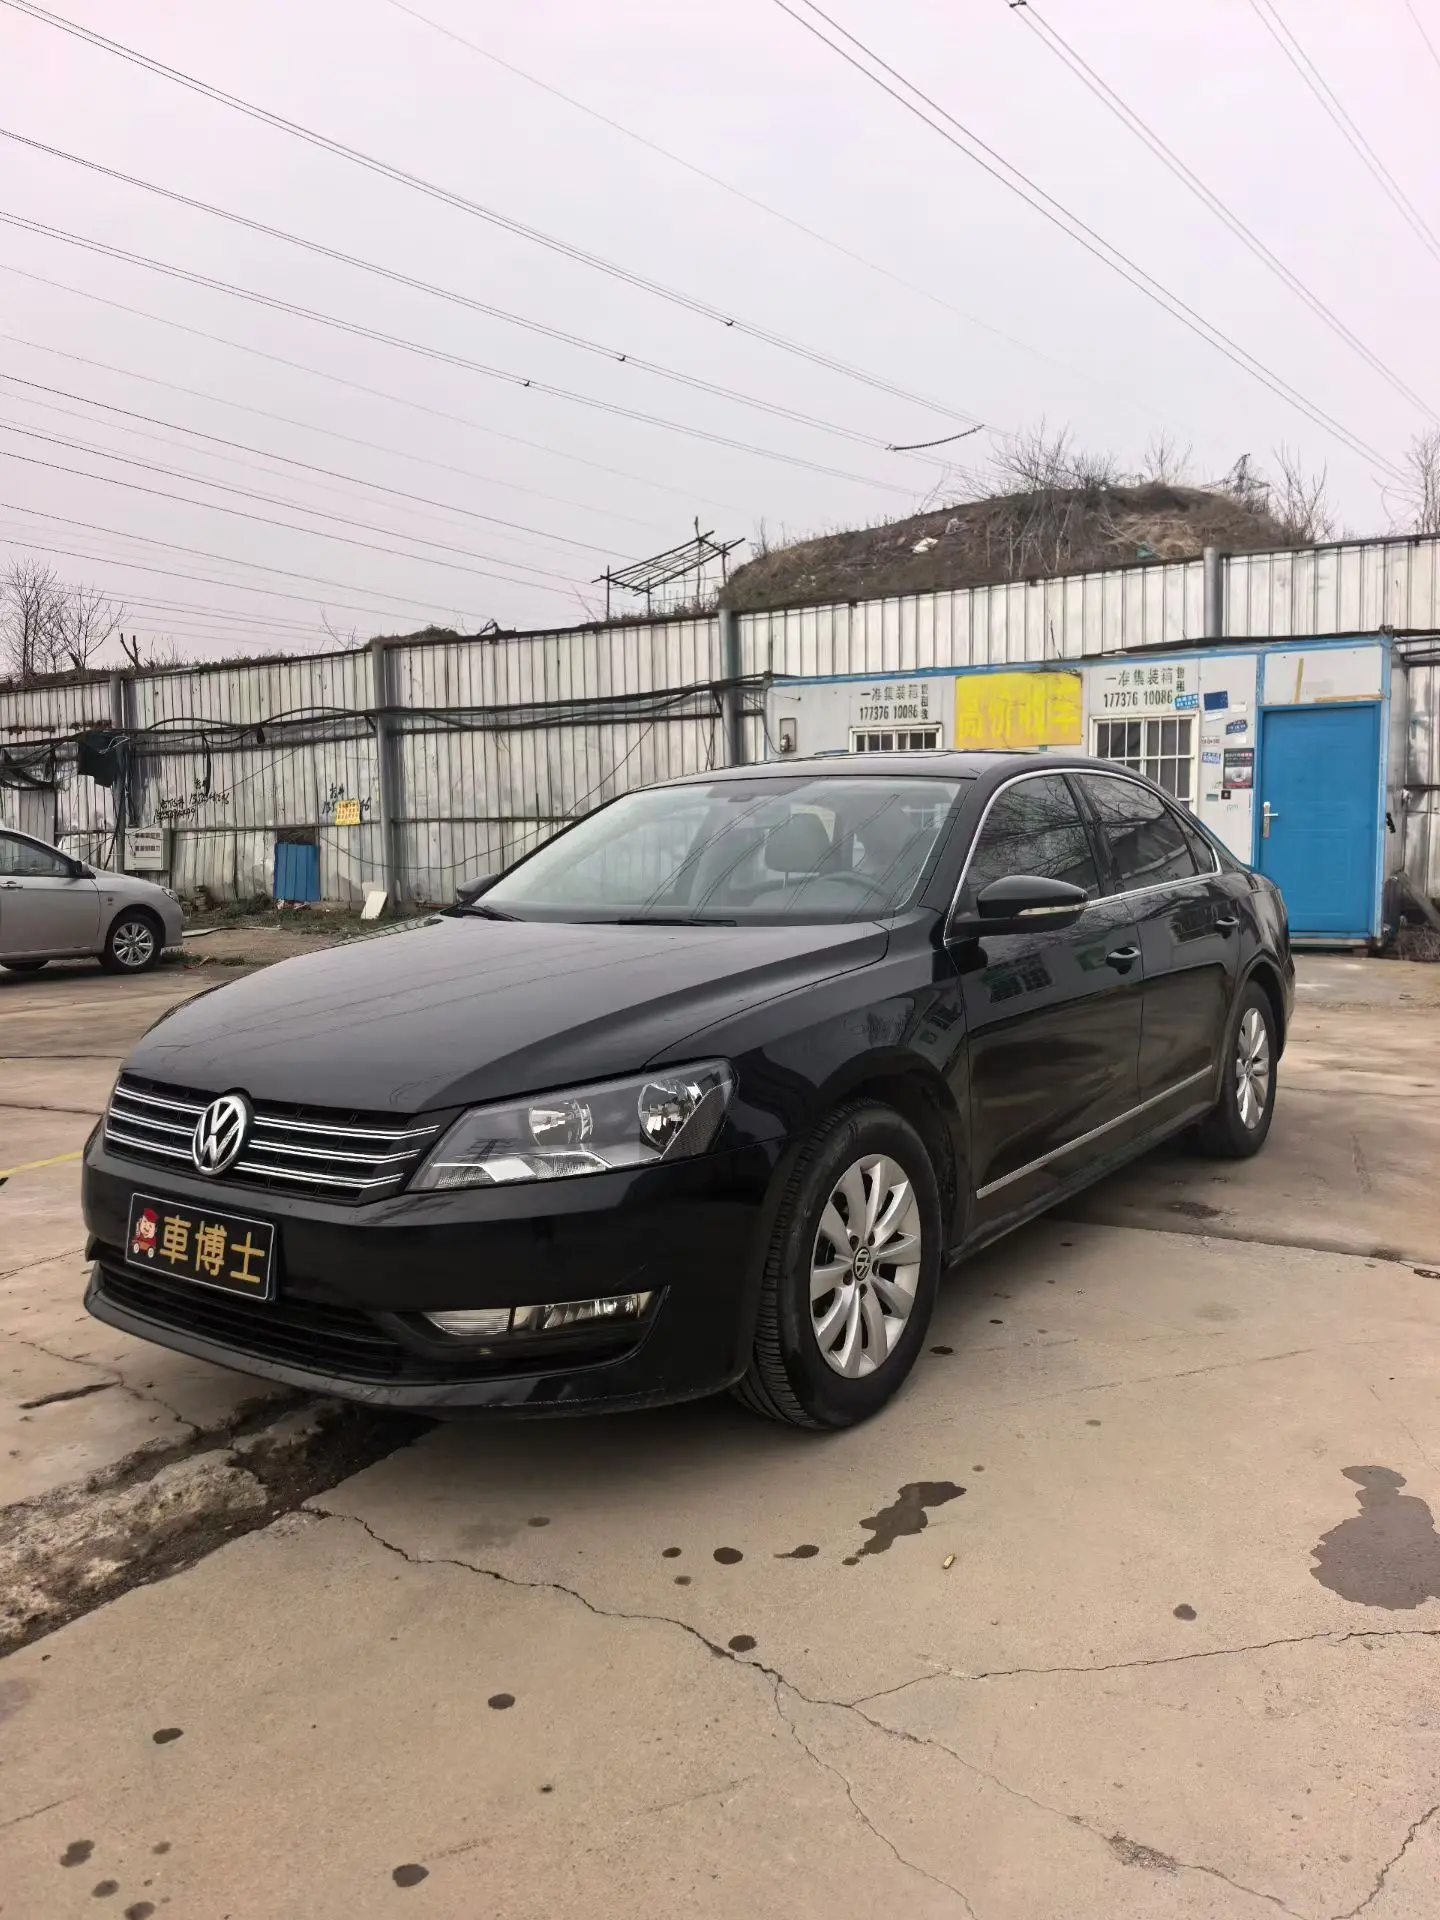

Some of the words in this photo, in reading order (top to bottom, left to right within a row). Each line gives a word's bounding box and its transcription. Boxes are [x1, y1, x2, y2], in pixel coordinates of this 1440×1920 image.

[1105, 667, 1173, 687] 一准集装箱
[860, 684, 918, 701] 一准集装箱
[1104, 691, 1138, 708] 177376
[1144, 689, 1173, 705] 10086
[860, 706, 889, 720] 177376
[894, 704, 918, 719] 10086
[159, 1214, 265, 1284] 車博士
